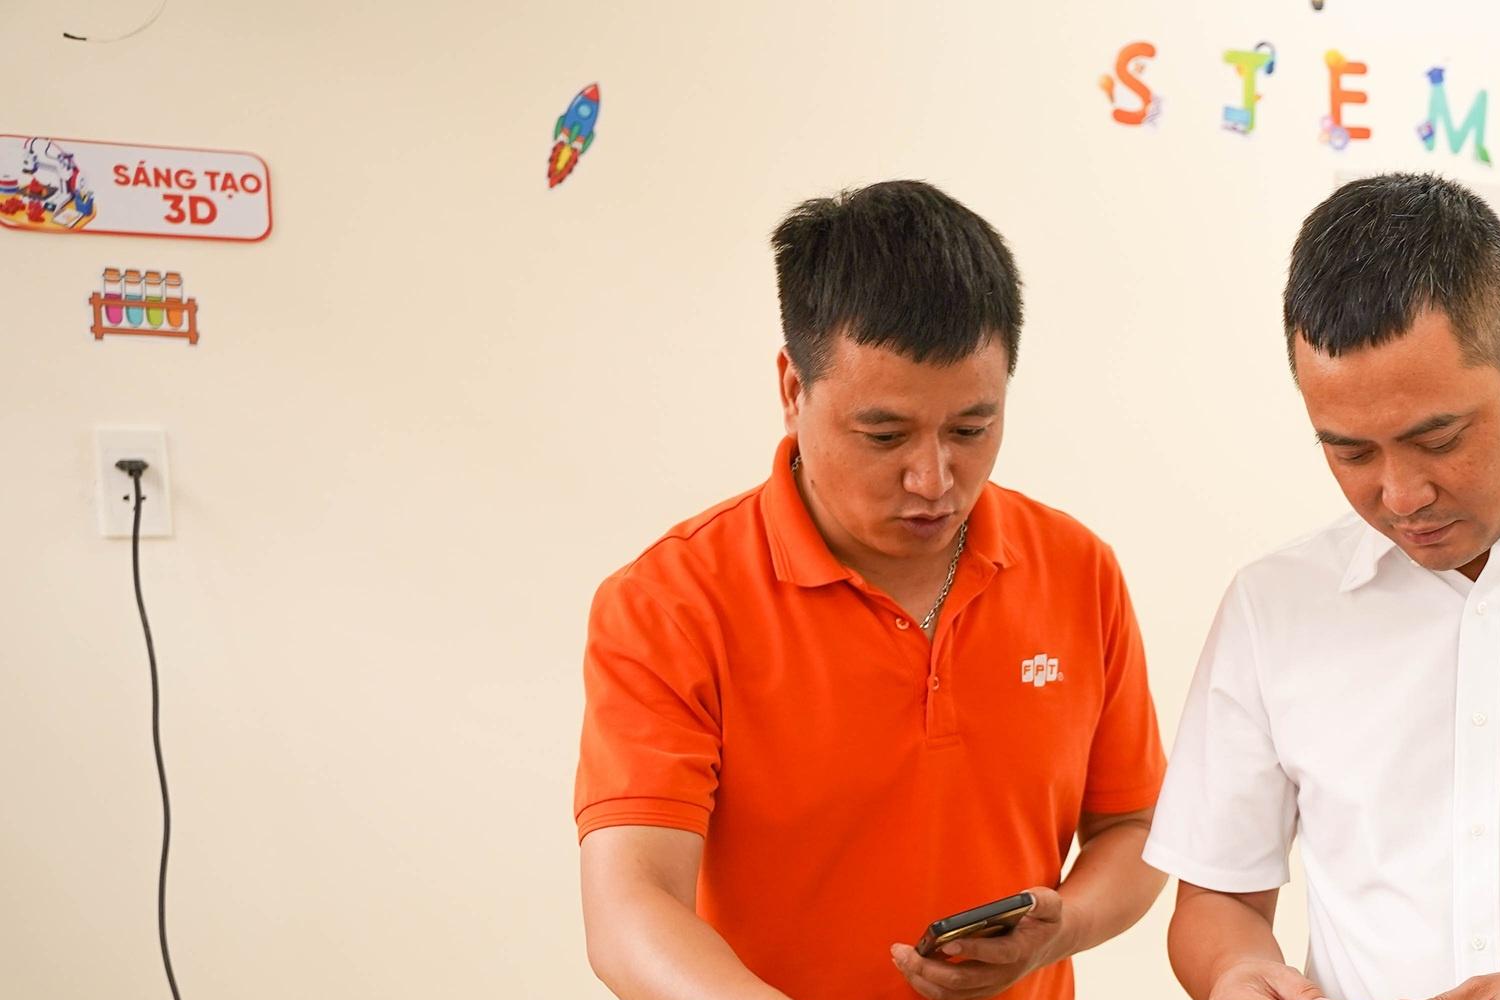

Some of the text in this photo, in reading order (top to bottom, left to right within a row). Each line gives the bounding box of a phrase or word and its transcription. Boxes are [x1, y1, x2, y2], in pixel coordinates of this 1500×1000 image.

[112, 160, 262, 199] SÁNG TẠO
[162, 193, 218, 225] 3D
[1021, 653, 1059, 687] FPT
